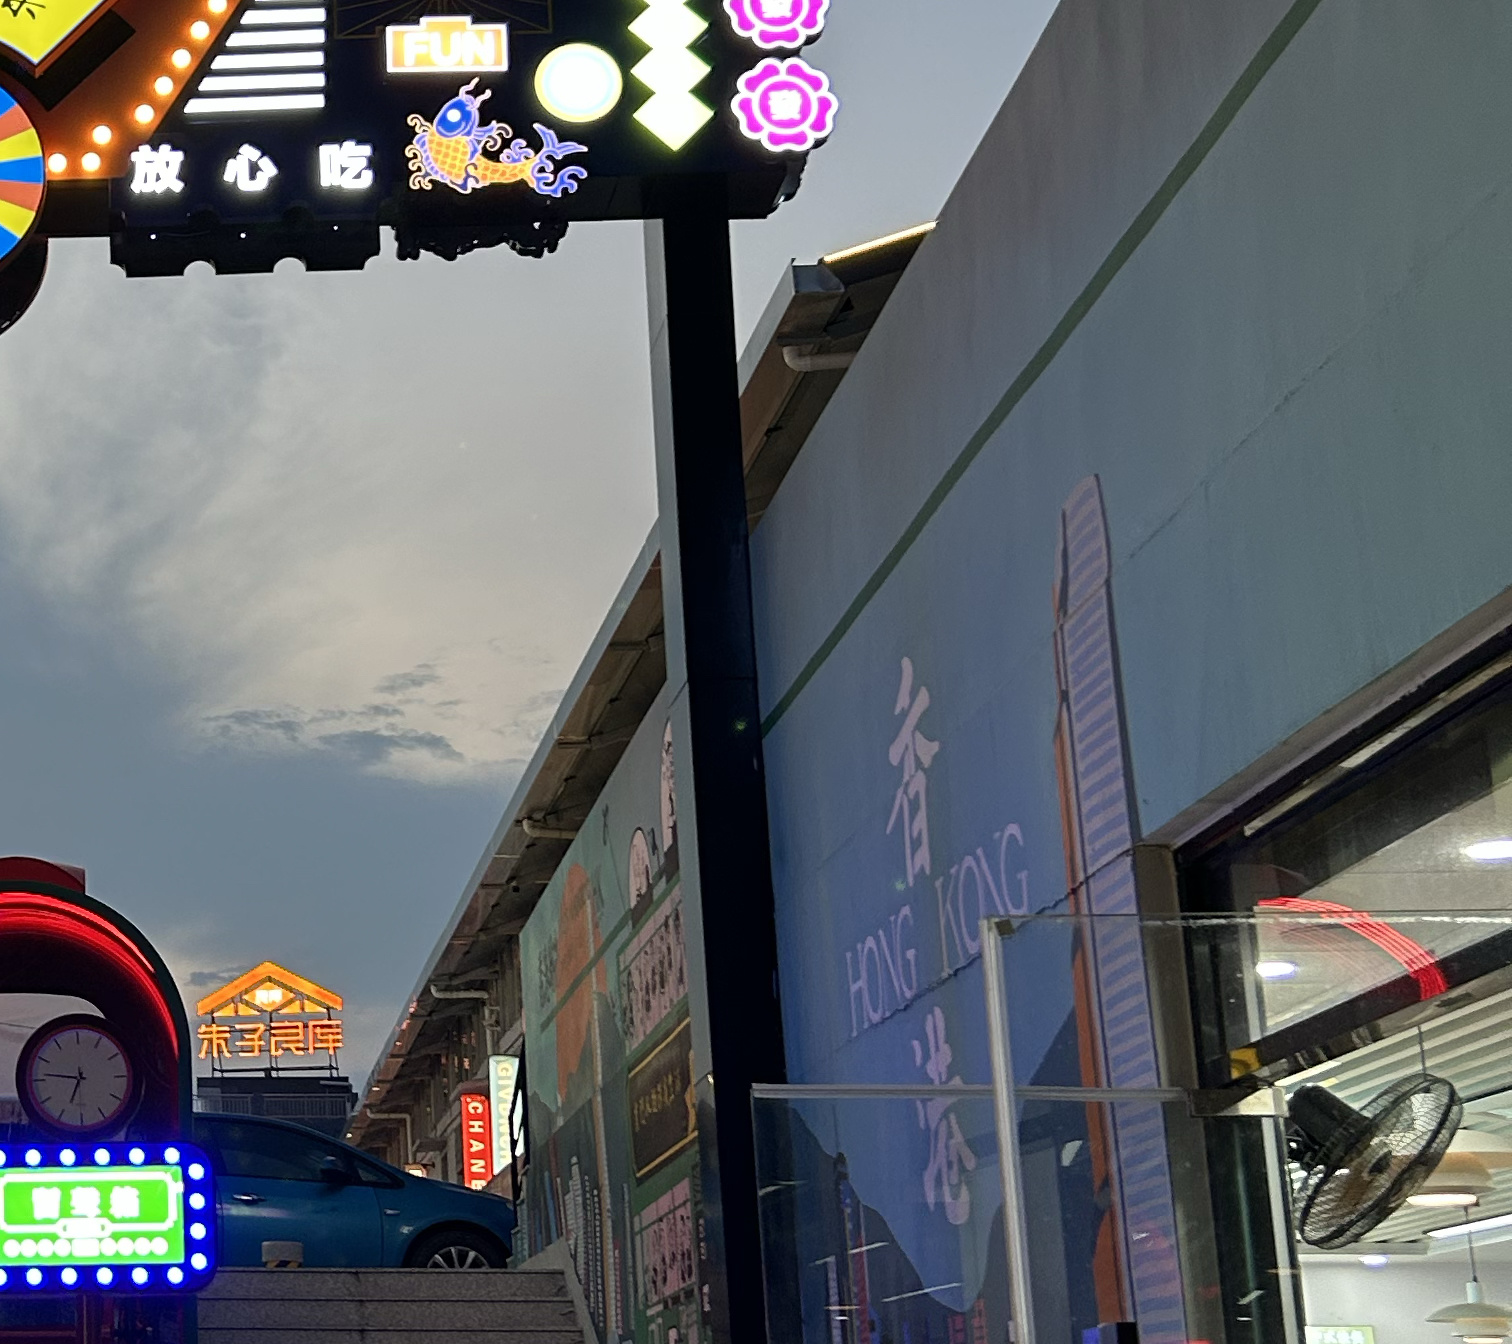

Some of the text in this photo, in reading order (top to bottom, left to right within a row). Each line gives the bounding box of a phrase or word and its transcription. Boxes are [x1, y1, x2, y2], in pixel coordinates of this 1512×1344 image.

[404, 31, 495, 66] FUN
[130, 142, 374, 194] 放心吃
[846, 906, 917, 1040] HONG
[936, 823, 1032, 978] KONG
[197, 1019, 344, 1060] 朱子良库
